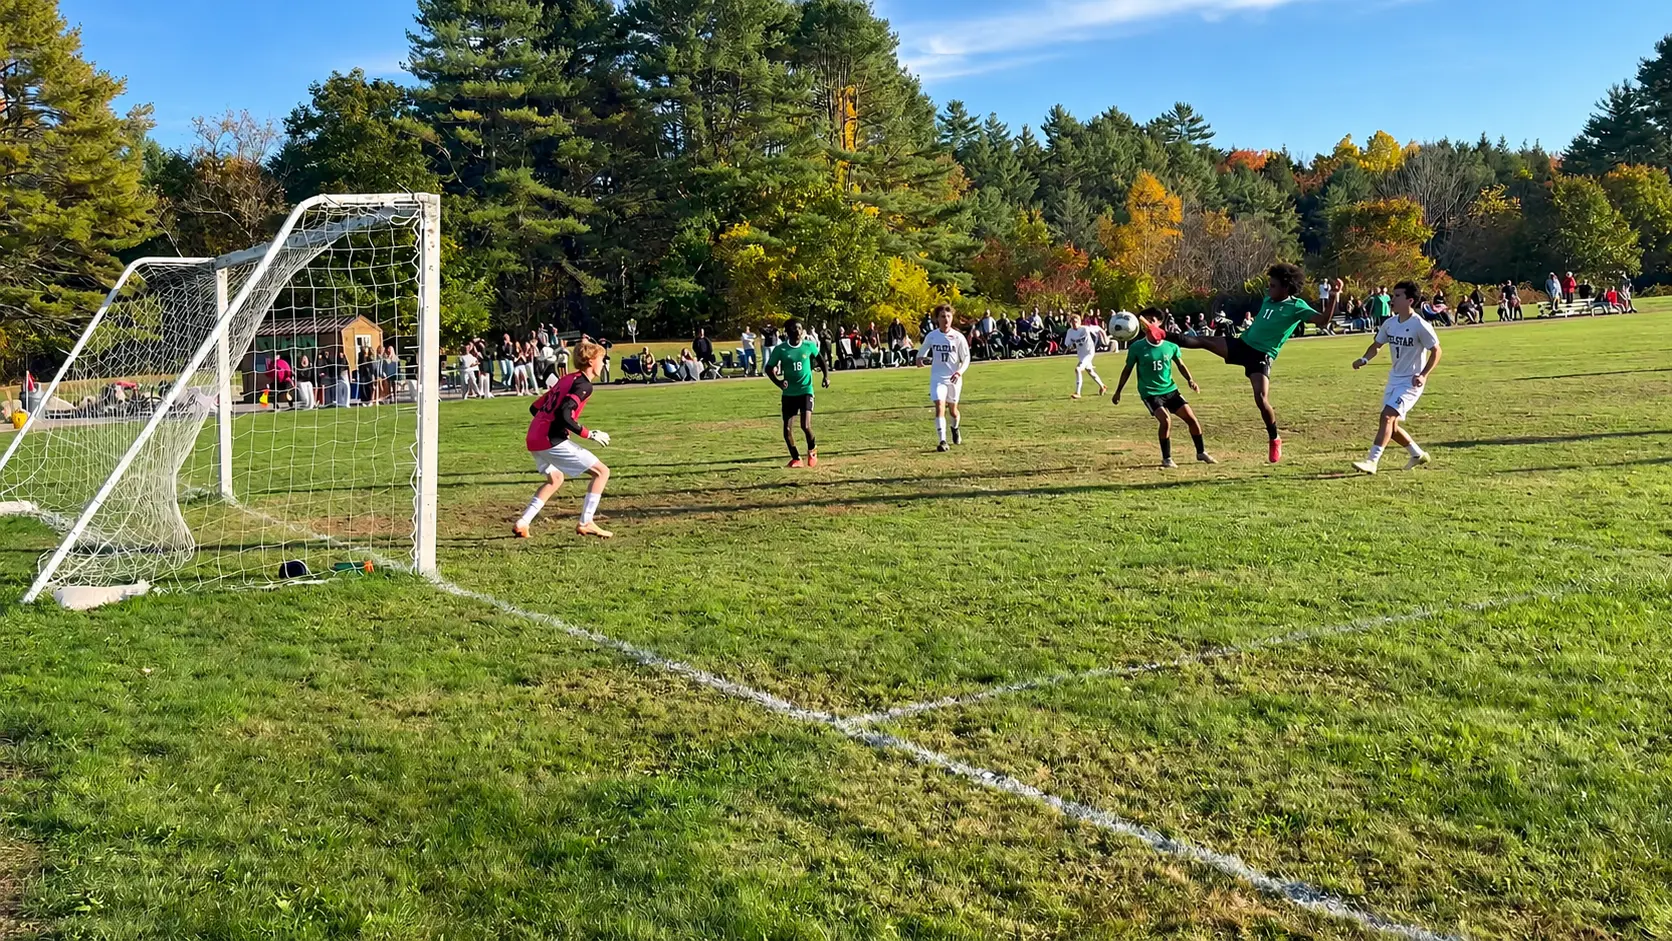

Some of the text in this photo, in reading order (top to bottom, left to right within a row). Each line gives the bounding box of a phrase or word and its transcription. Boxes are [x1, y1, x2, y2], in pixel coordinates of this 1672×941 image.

[1263, 308, 1274, 319] 11
[1395, 346, 1400, 359] 1
[793, 361, 803, 371] 18
[1153, 360, 1163, 371] 15
